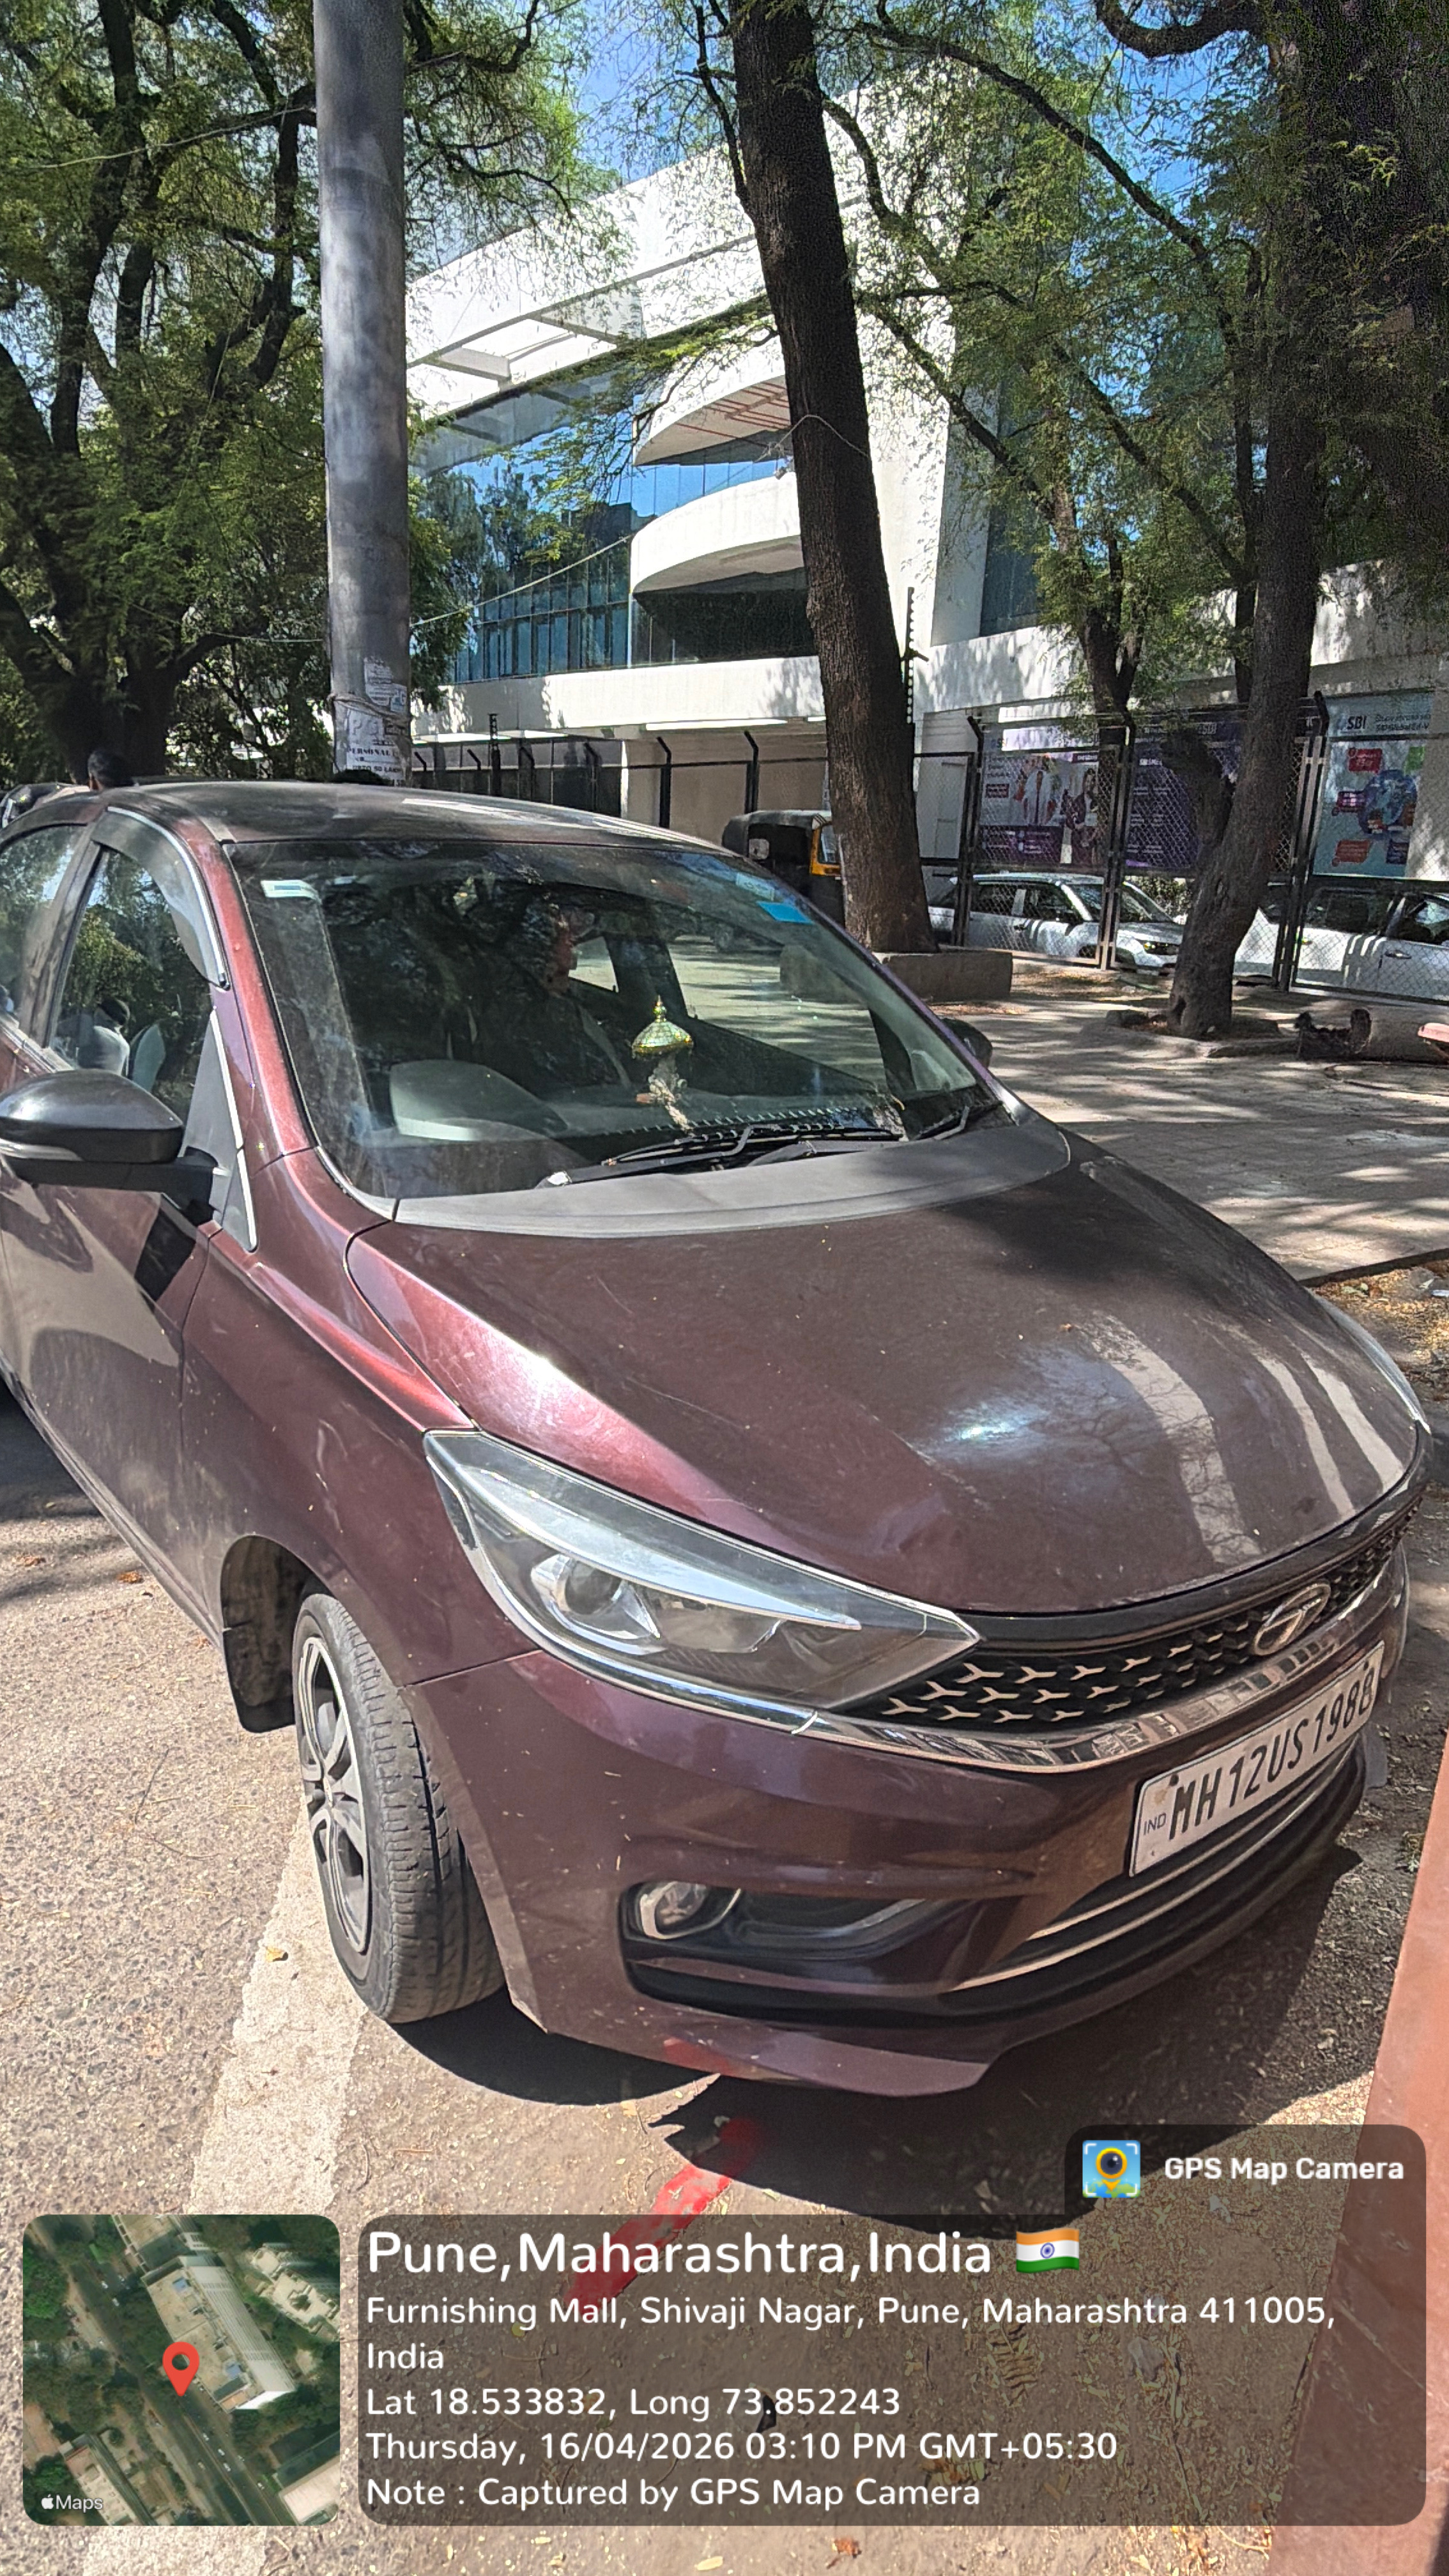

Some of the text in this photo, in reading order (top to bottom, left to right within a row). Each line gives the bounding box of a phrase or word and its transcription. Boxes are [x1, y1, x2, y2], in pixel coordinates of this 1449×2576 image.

[1347, 716, 1367, 730] SBI
[1169, 1672, 1375, 1840] MH12US1988
[1144, 1813, 1167, 1836] IND
